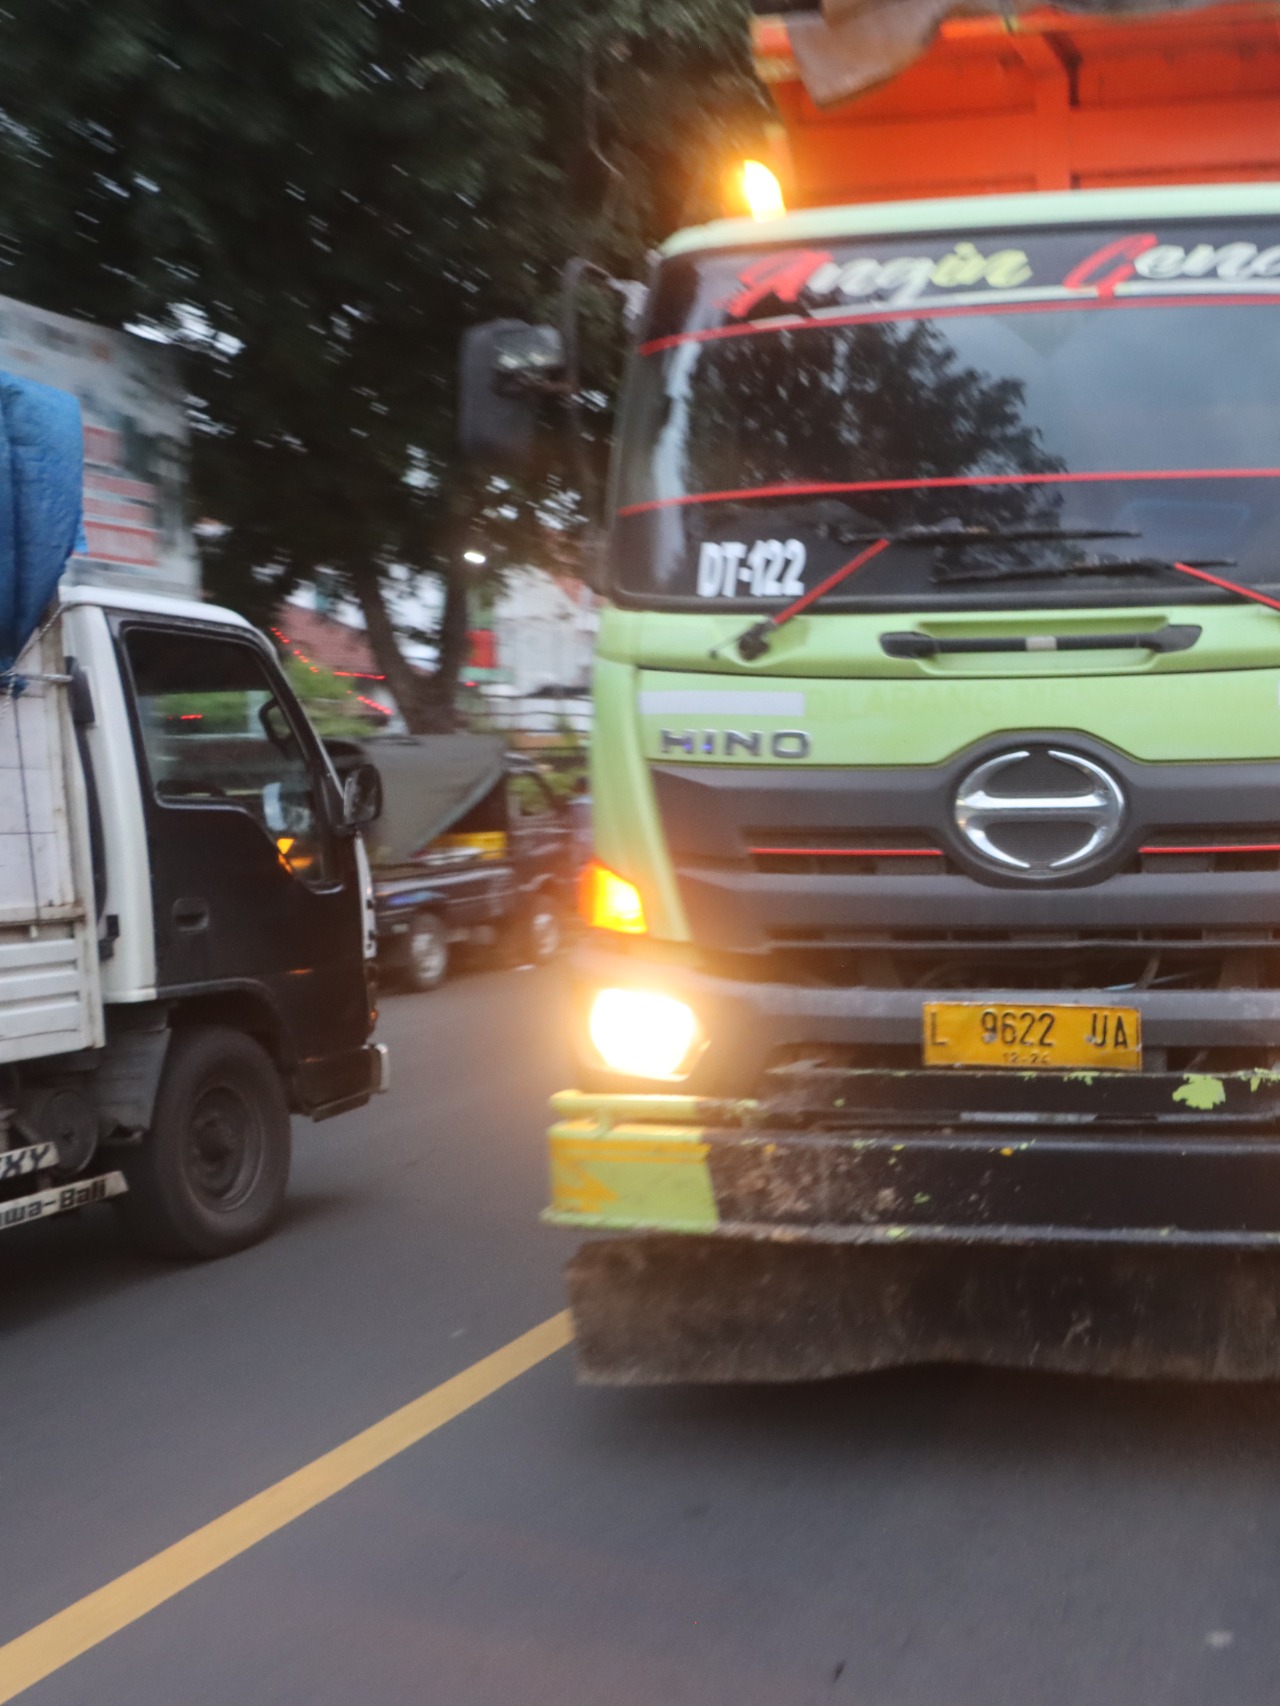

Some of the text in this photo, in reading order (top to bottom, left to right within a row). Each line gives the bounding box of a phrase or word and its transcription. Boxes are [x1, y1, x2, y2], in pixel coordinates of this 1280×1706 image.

[726, 242, 1033, 317] Angin
[696, 538, 807, 597] DT-122
[660, 729, 812, 759] HINO
[930, 1011, 1129, 1048] L 9622 UA
